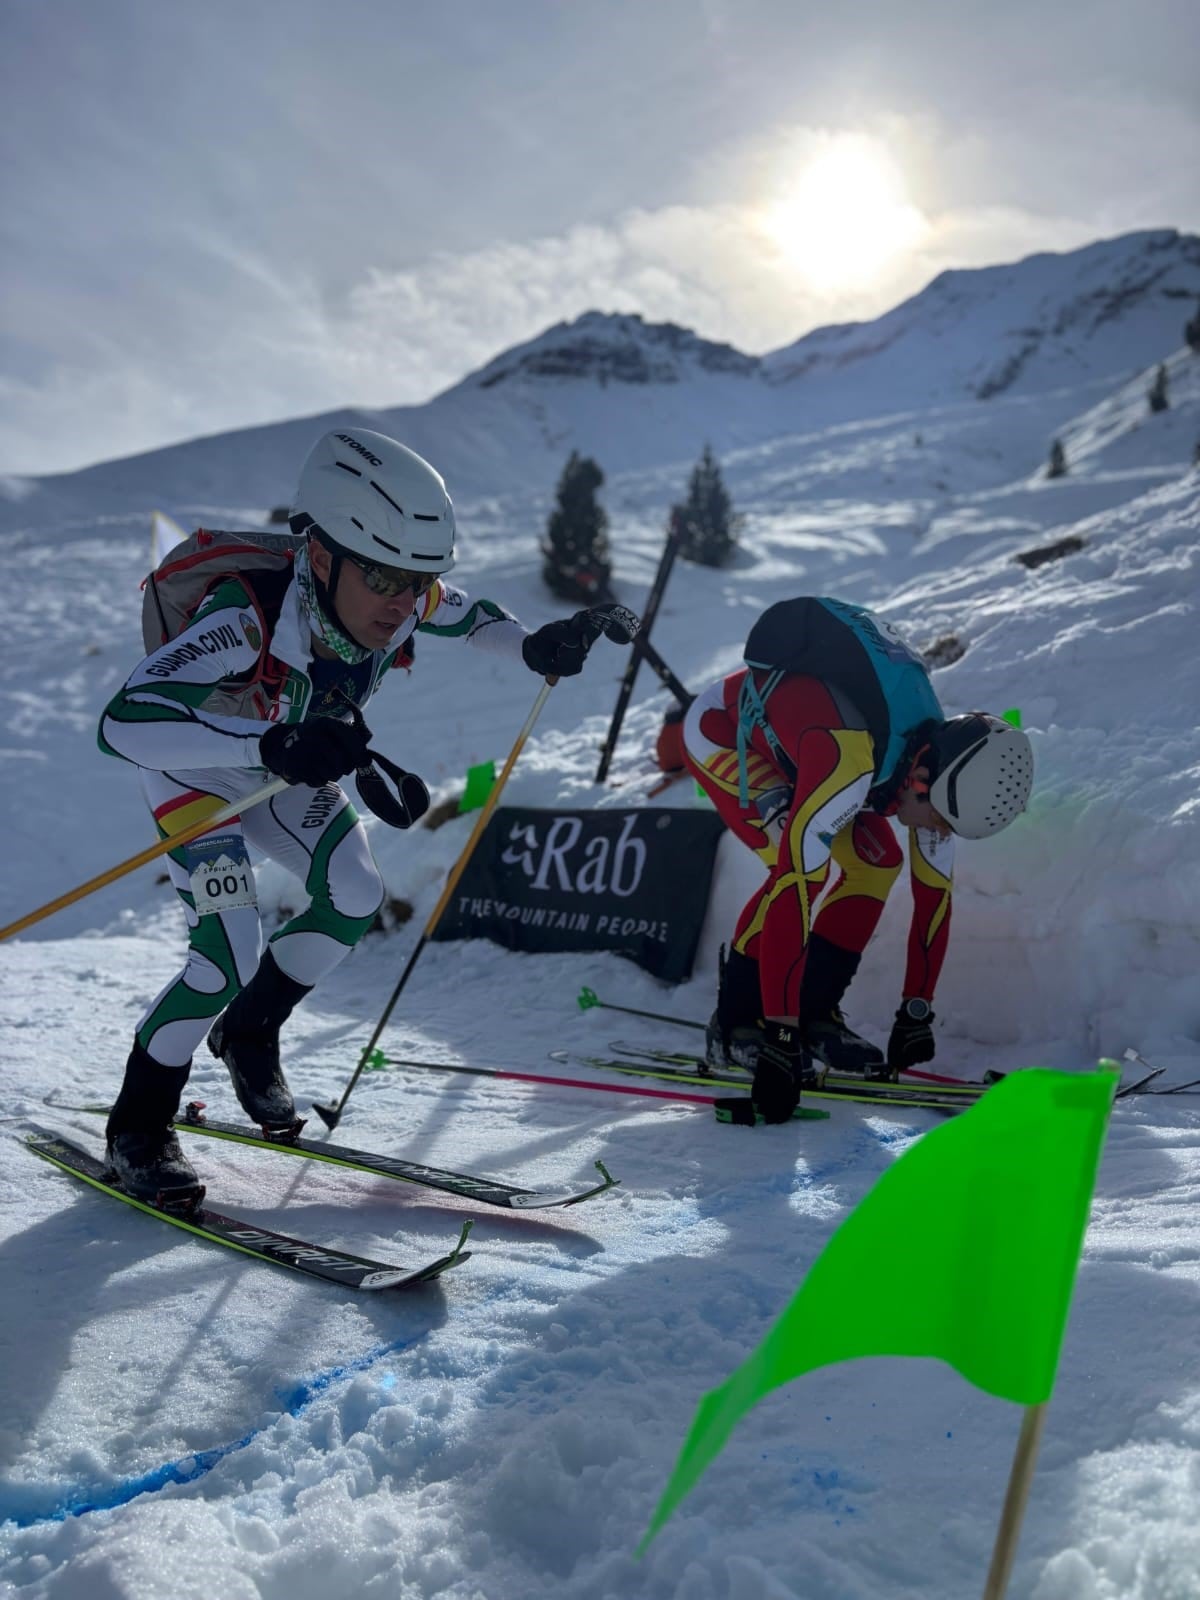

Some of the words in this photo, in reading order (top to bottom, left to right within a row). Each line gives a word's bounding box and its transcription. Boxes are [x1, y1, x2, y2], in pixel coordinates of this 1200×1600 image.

[334, 434, 383, 467] ATOMIC
[198, 624, 243, 654] CIVIL
[301, 785, 341, 829] GUARD
[203, 863, 237, 875] SPRINT
[529, 812, 647, 897] Rab
[205, 874, 249, 898] 001
[459, 898, 492, 917] THE
[596, 915, 669, 943] PEOPLE
[226, 1230, 377, 1271] DYNAFIT
